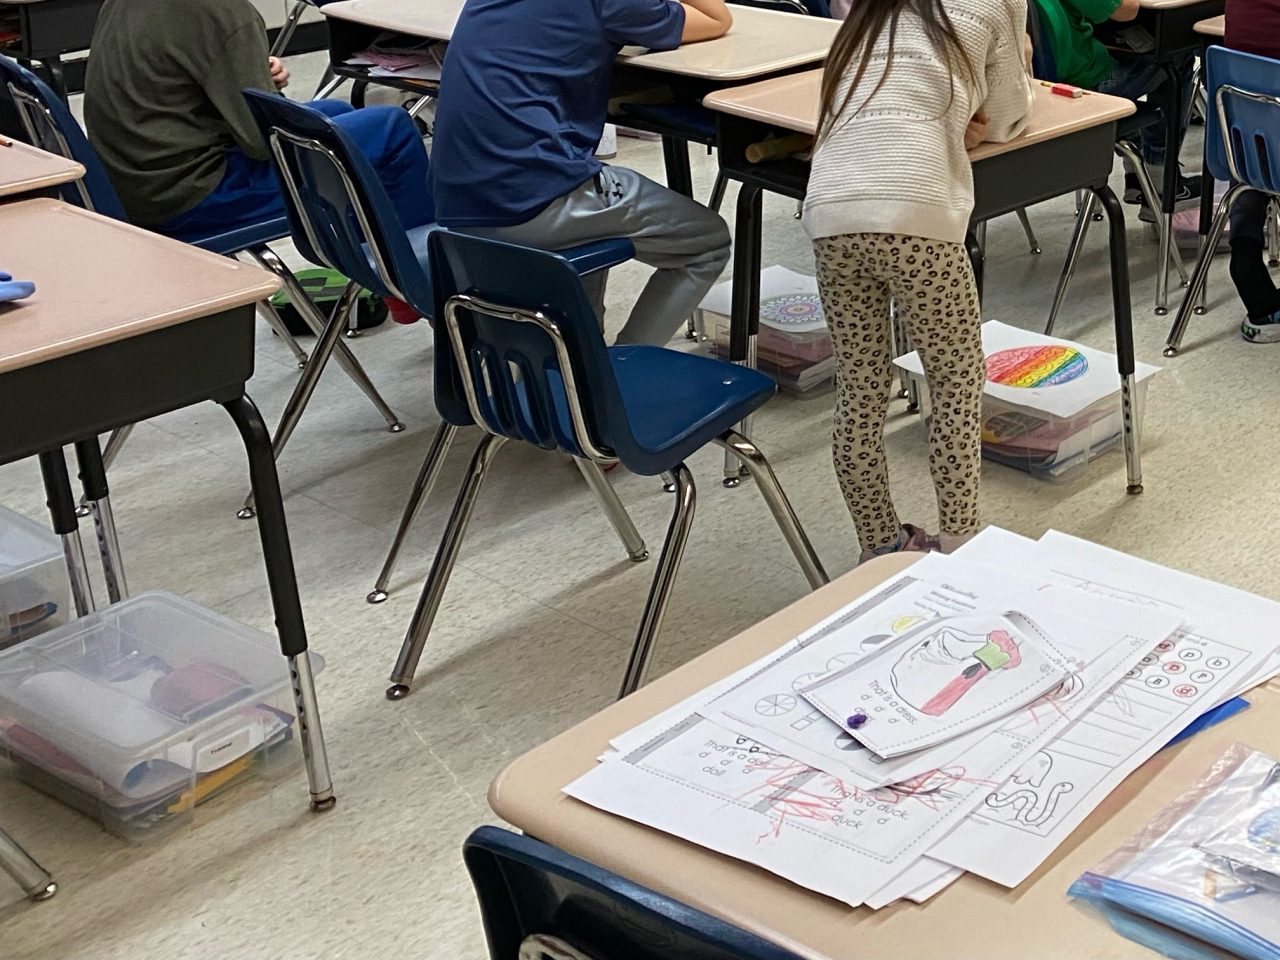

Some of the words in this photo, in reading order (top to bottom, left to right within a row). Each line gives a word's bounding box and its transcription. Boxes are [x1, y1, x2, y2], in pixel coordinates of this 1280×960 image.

[867, 680, 887, 697] That
[702, 765, 727, 777] doll
[831, 813, 864, 829] duck
